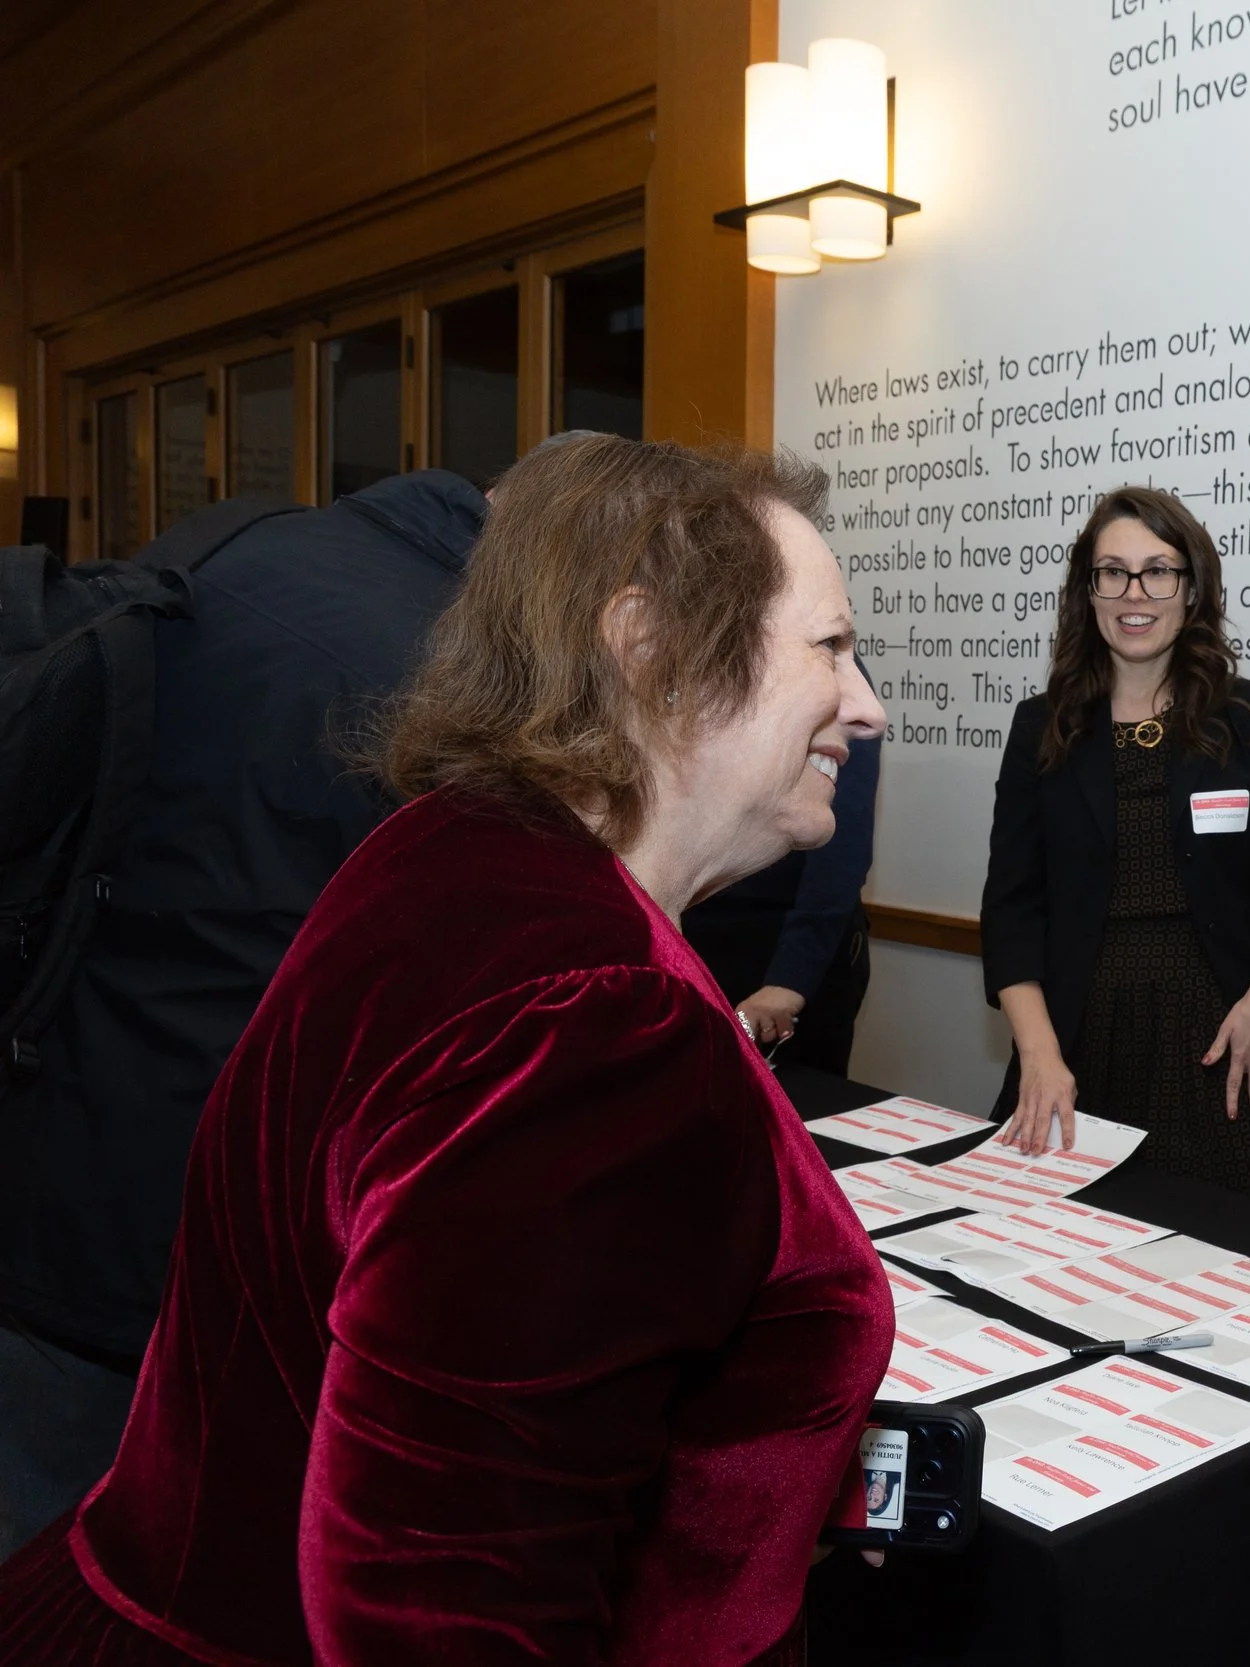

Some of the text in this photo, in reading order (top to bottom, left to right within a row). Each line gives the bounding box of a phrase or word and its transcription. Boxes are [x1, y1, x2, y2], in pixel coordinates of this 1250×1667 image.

[1109, 20, 1176, 76] each
[1109, 80, 1161, 132] soul
[1176, 72, 1247, 114] have
[816, 376, 878, 407] Where
[886, 368, 929, 397] laws
[937, 359, 989, 390] exist,
[999, 356, 1019, 381] to
[1028, 348, 1089, 380] carry
[1099, 331, 1156, 366] them
[1168, 322, 1216, 356] out;
[815, 425, 841, 450] act
[849, 421, 863, 445] in
[872, 412, 899, 443] the
[907, 408, 955, 447] spirit
[963, 397, 984, 432] of
[992, 386, 1106, 438] precedent
[1115, 372, 1163, 413] and
[838, 461, 878, 488] hear
[886, 445, 989, 494] proposals.
[1007, 442, 1030, 472] To
[1040, 435, 1101, 470] show
[1111, 424, 1235, 463] favoritism
[842, 499, 910, 530] without
[917, 505, 954, 533] any
[962, 490, 1052, 523] constant
[849, 540, 926, 581] possible
[934, 545, 951, 568] to
[961, 536, 1011, 567] have
[873, 586, 902, 614] But
[909, 590, 926, 613] to
[935, 582, 983, 613] have
[992, 593, 1005, 612] a
[961, 630, 1040, 658] ancient
[881, 681, 892, 699] a
[900, 670, 955, 710] thing.
[972, 671, 1012, 704] This
[903, 712, 946, 745] born
[956, 714, 1001, 748] from
[878, 1452, 902, 1460] JUDITH
